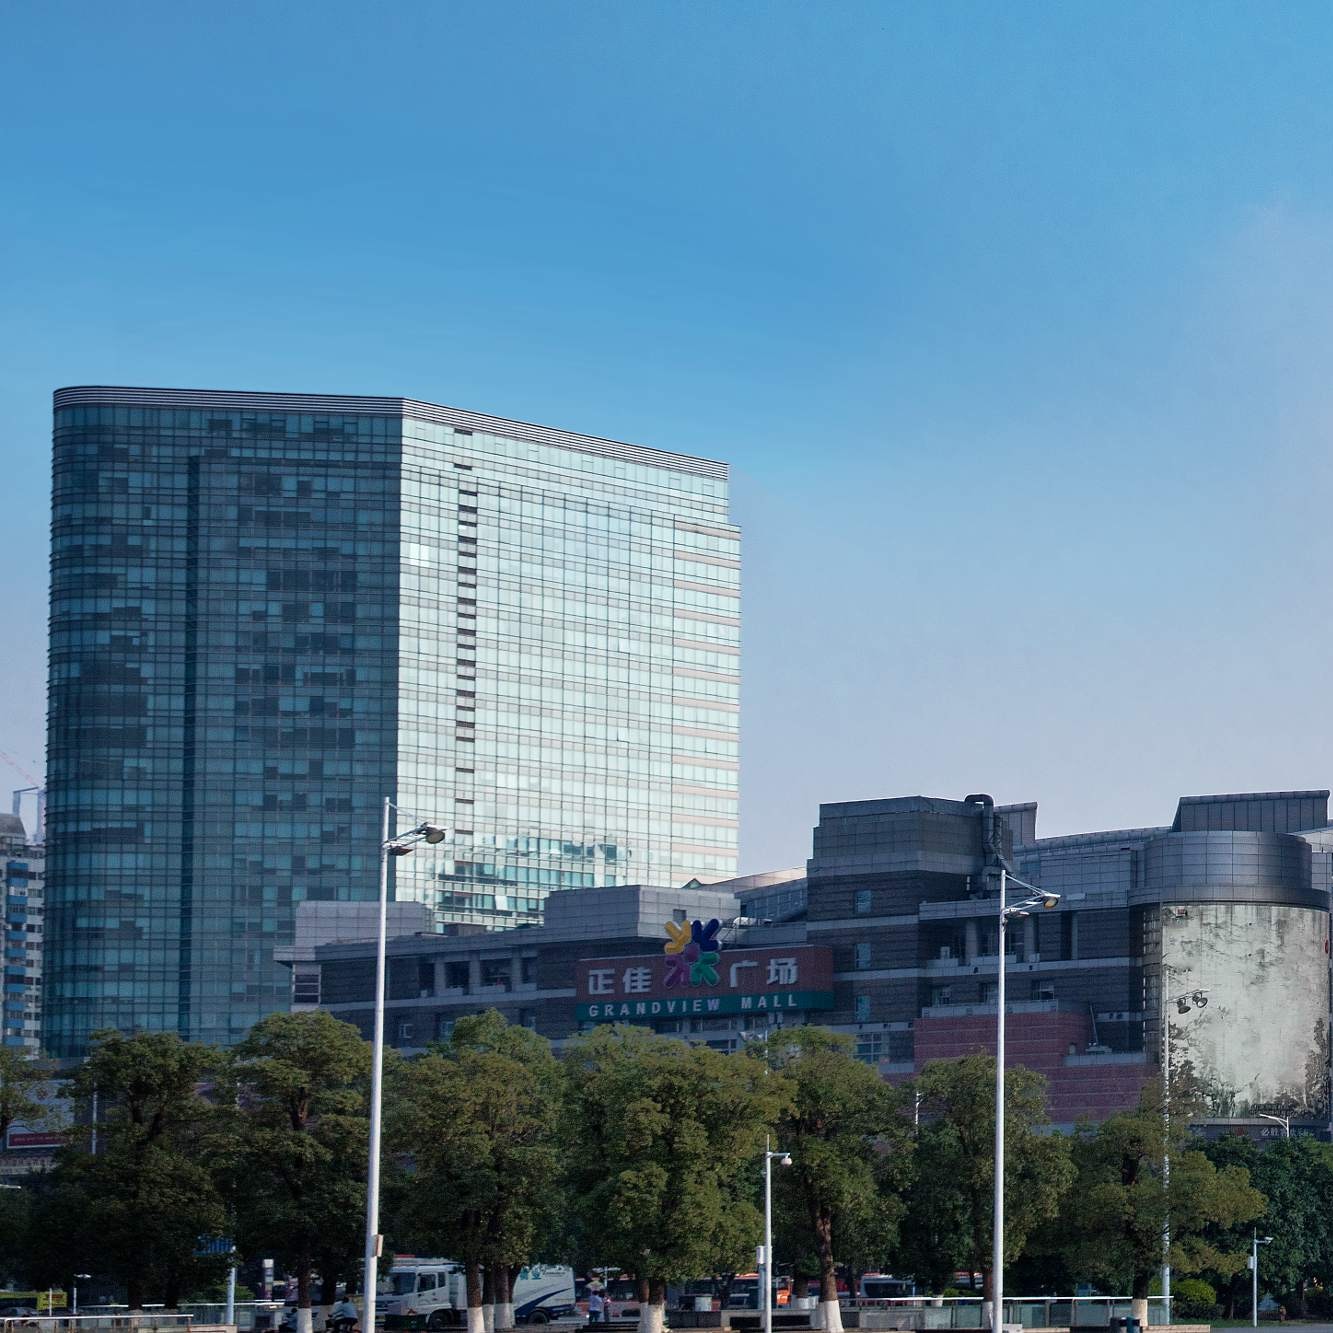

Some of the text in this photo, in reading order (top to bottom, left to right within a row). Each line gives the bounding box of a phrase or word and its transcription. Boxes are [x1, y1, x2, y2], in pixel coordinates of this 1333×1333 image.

[588, 956, 799, 995] 正佳 广场
[589, 994, 797, 1017] GRANDVIEW MALL
